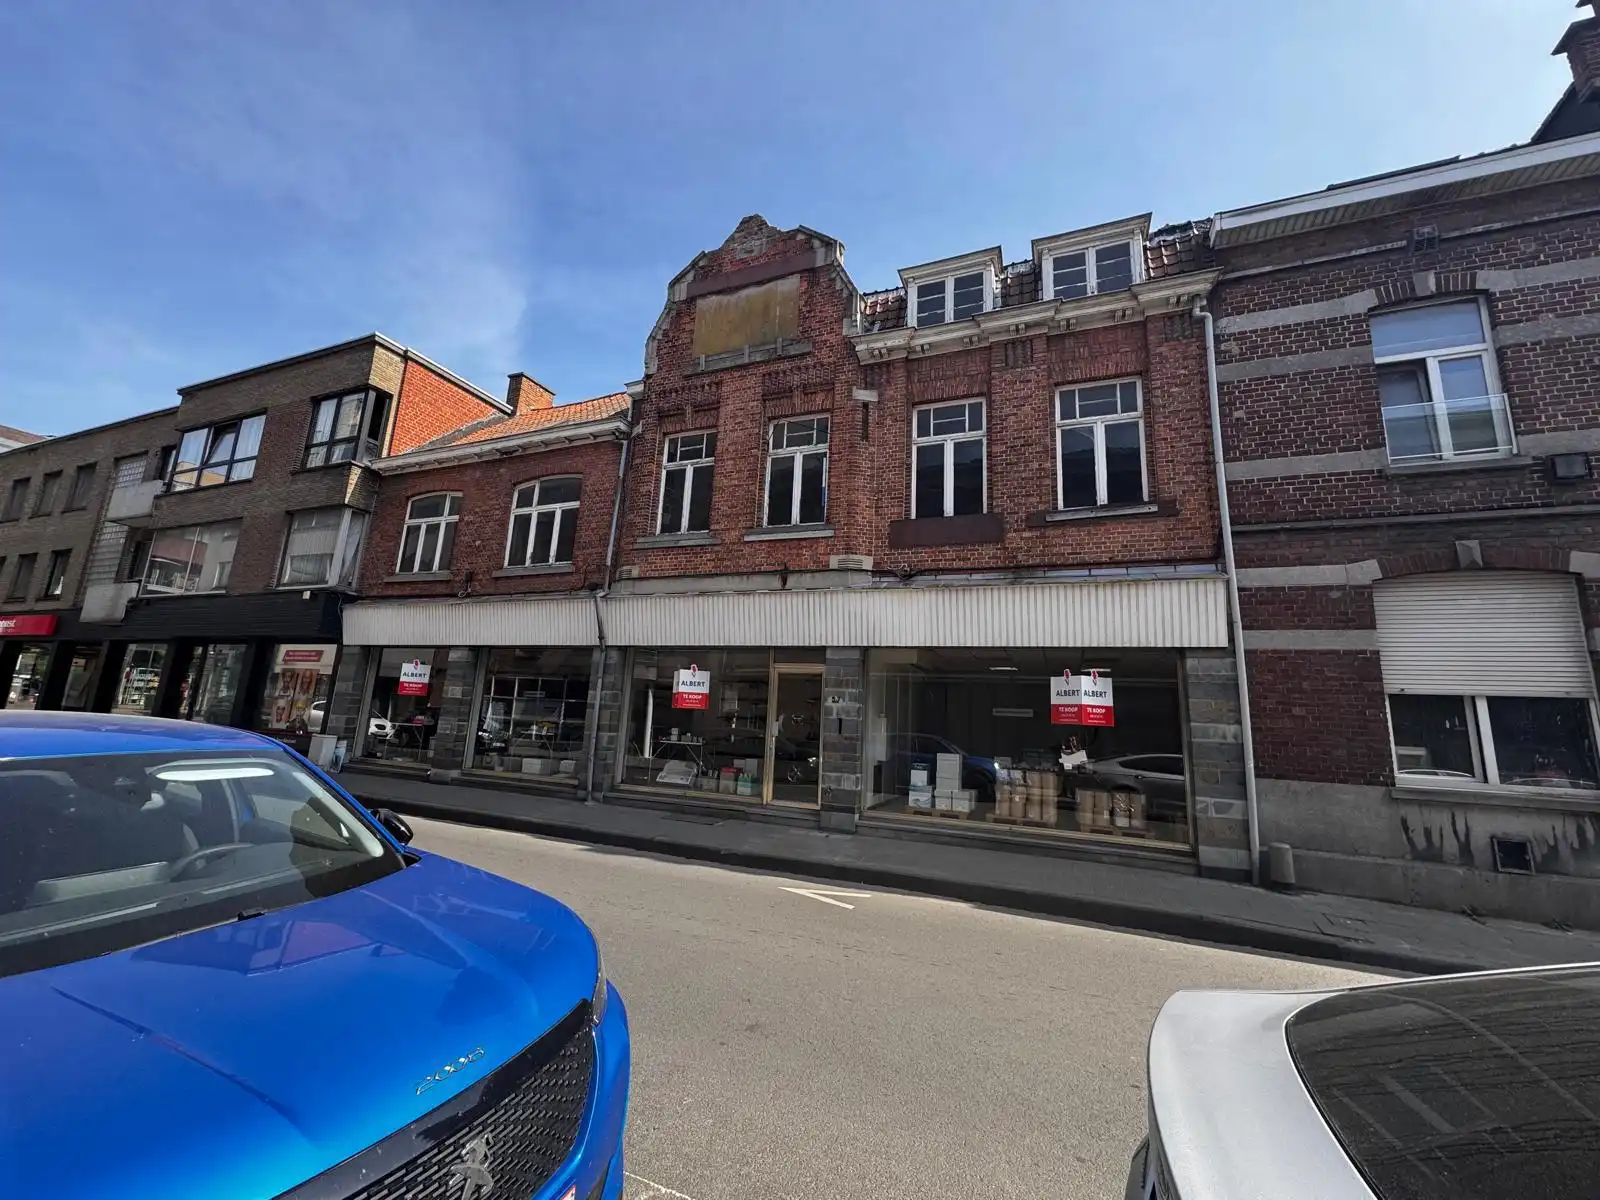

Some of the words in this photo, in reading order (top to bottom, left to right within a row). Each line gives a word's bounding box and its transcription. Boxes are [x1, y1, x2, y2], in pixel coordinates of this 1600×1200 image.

[1055, 689, 1080, 697] ALBERT
[1083, 689, 1107, 698] ALBERT
[415, 1047, 485, 1096] 2008
